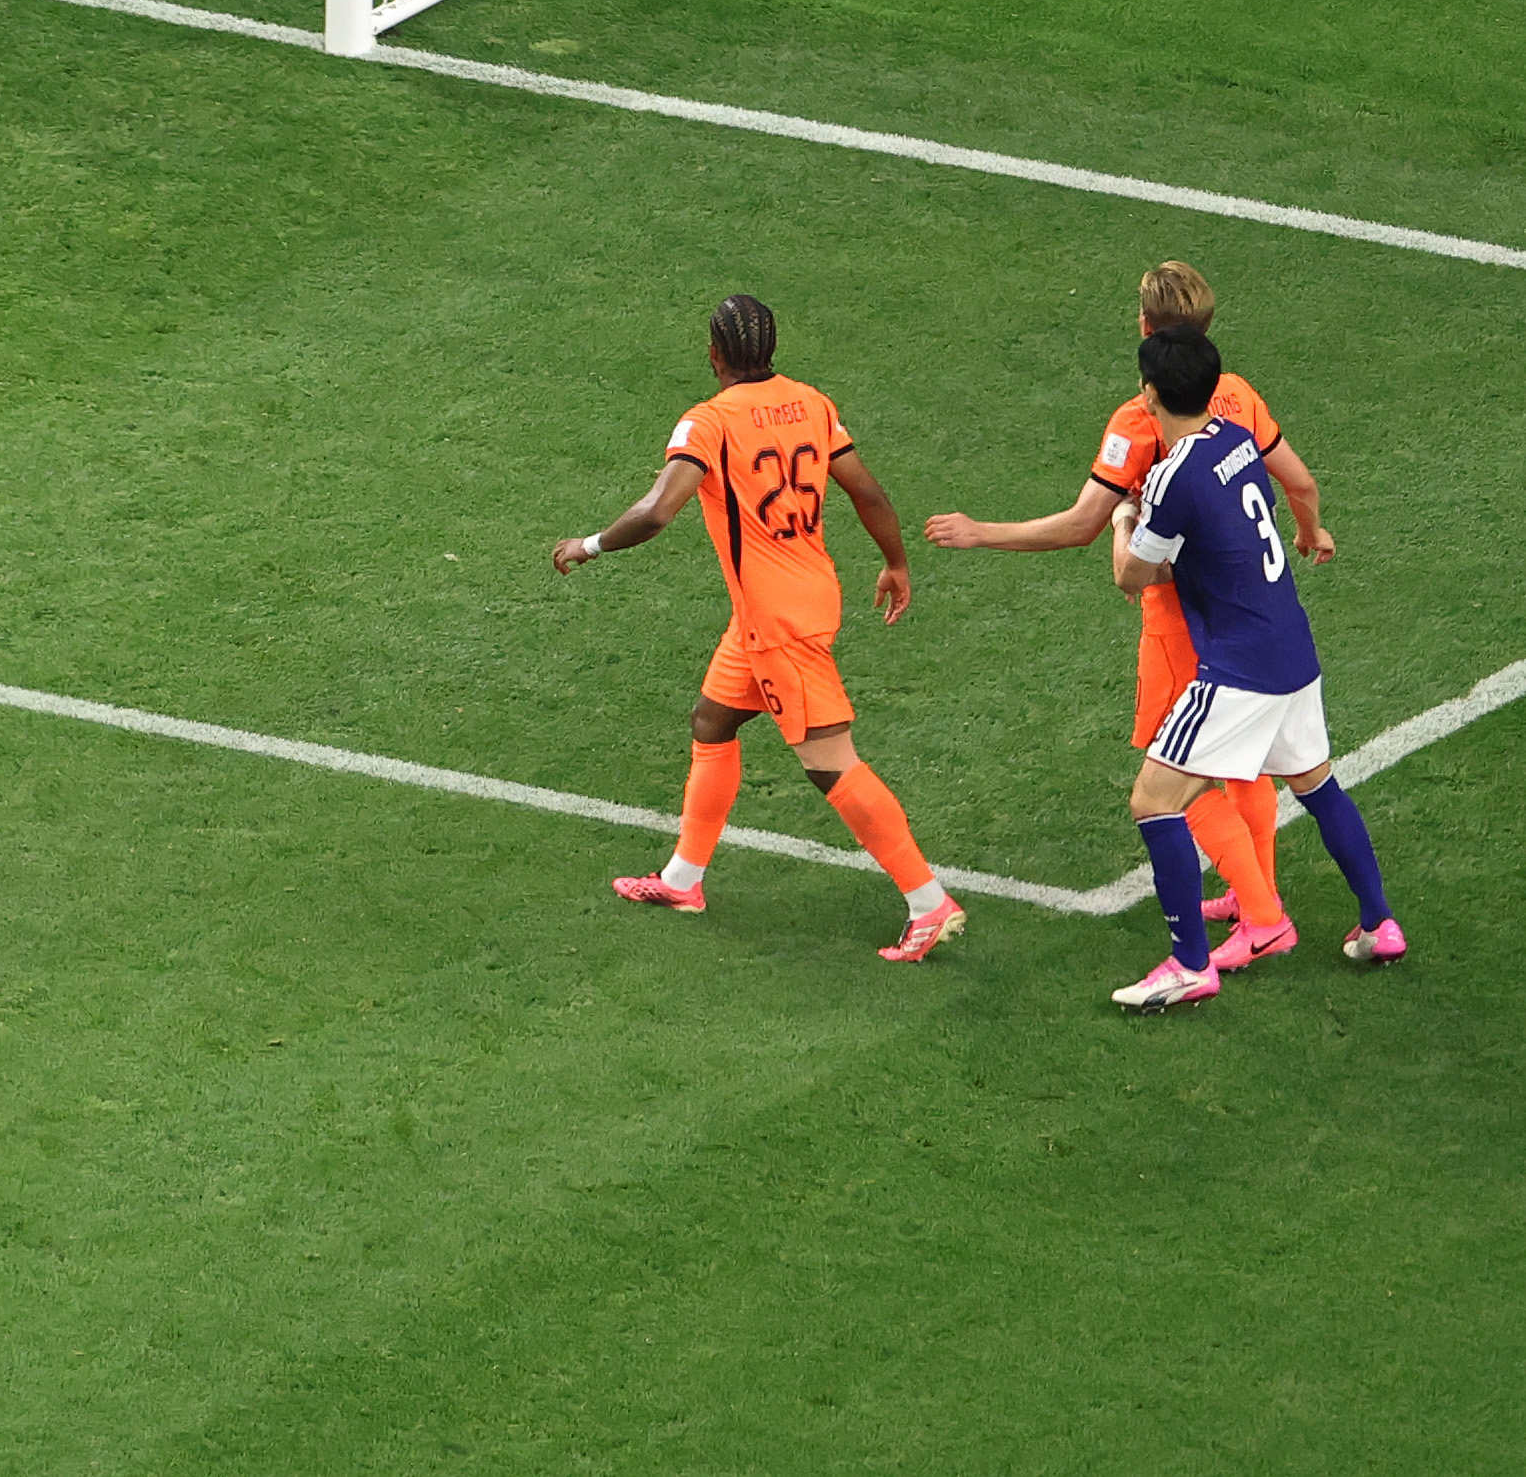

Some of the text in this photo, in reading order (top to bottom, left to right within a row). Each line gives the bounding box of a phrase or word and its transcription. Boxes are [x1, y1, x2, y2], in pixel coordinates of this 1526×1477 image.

[751, 441, 821, 541] 26
[1241, 482, 1286, 583] 3
[761, 678, 784, 715] 6
